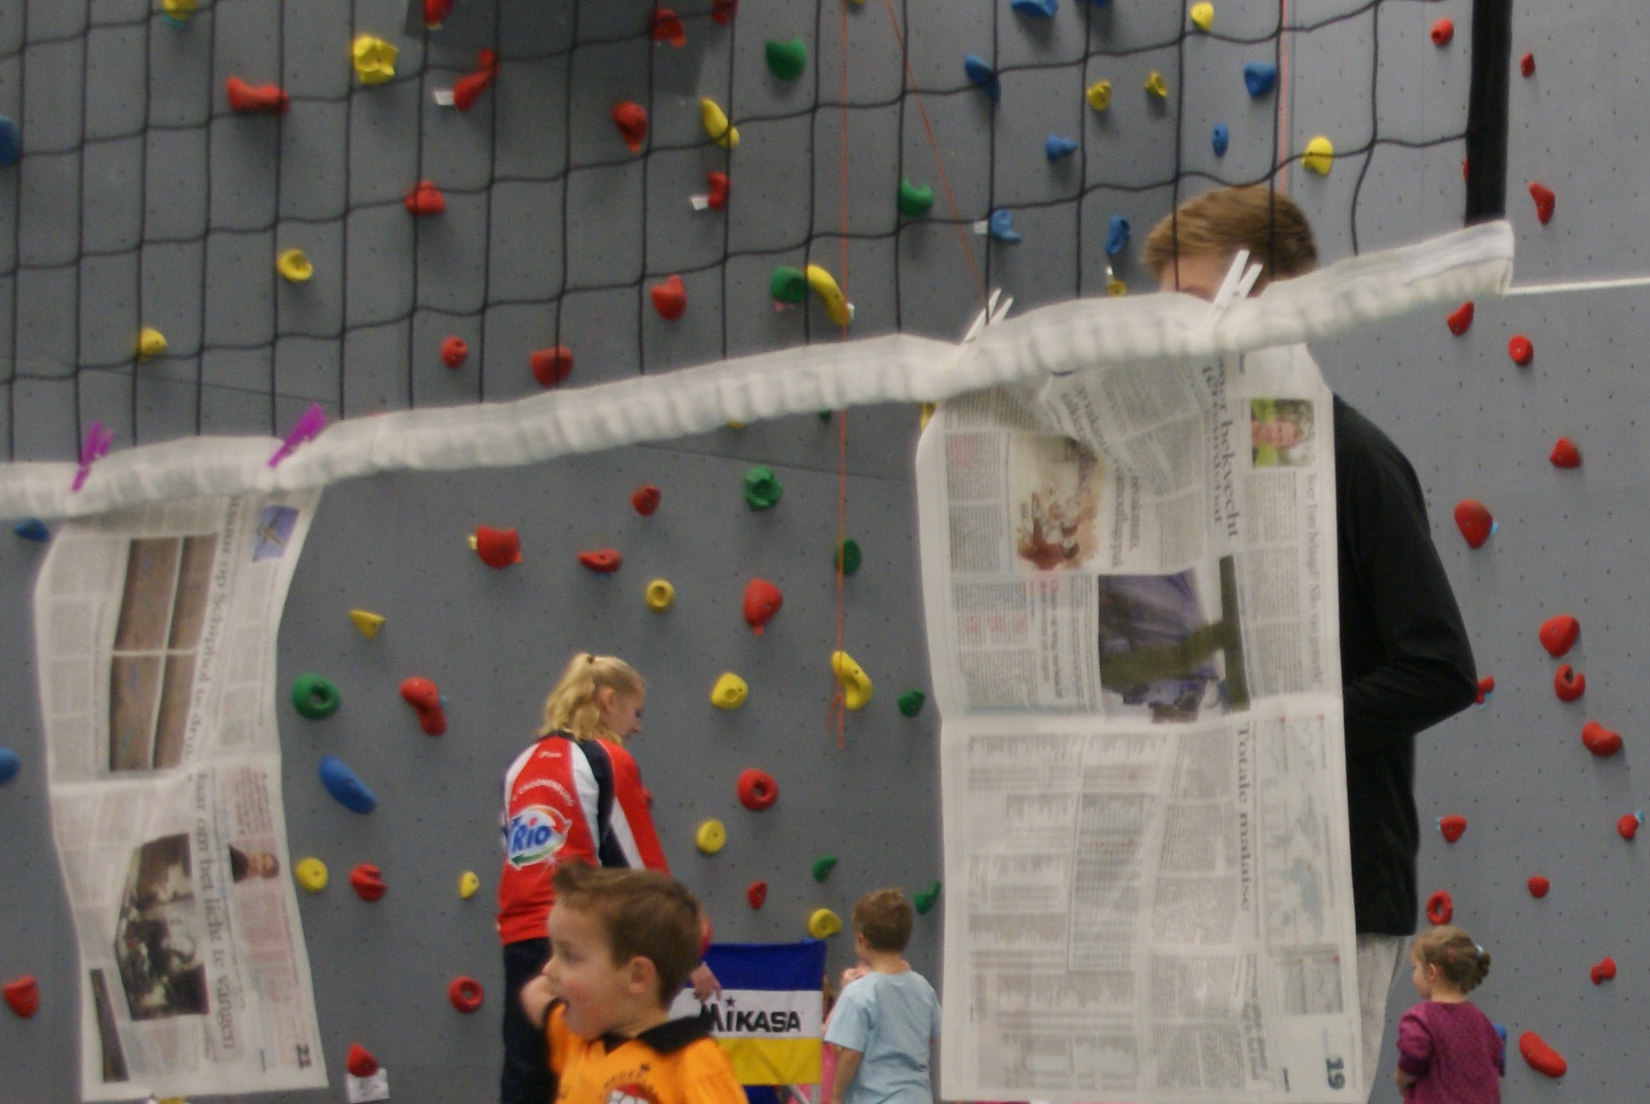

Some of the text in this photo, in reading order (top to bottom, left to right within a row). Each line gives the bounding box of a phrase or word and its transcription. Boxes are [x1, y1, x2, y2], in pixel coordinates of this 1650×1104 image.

[1237, 722, 1254, 912] Totale malaise
[200, 858, 218, 892] het
[205, 897, 226, 942] licht
[214, 948, 230, 969] te
[214, 975, 237, 1049] vangen
[297, 1042, 313, 1070] 21
[1325, 1057, 1346, 1091] 19
